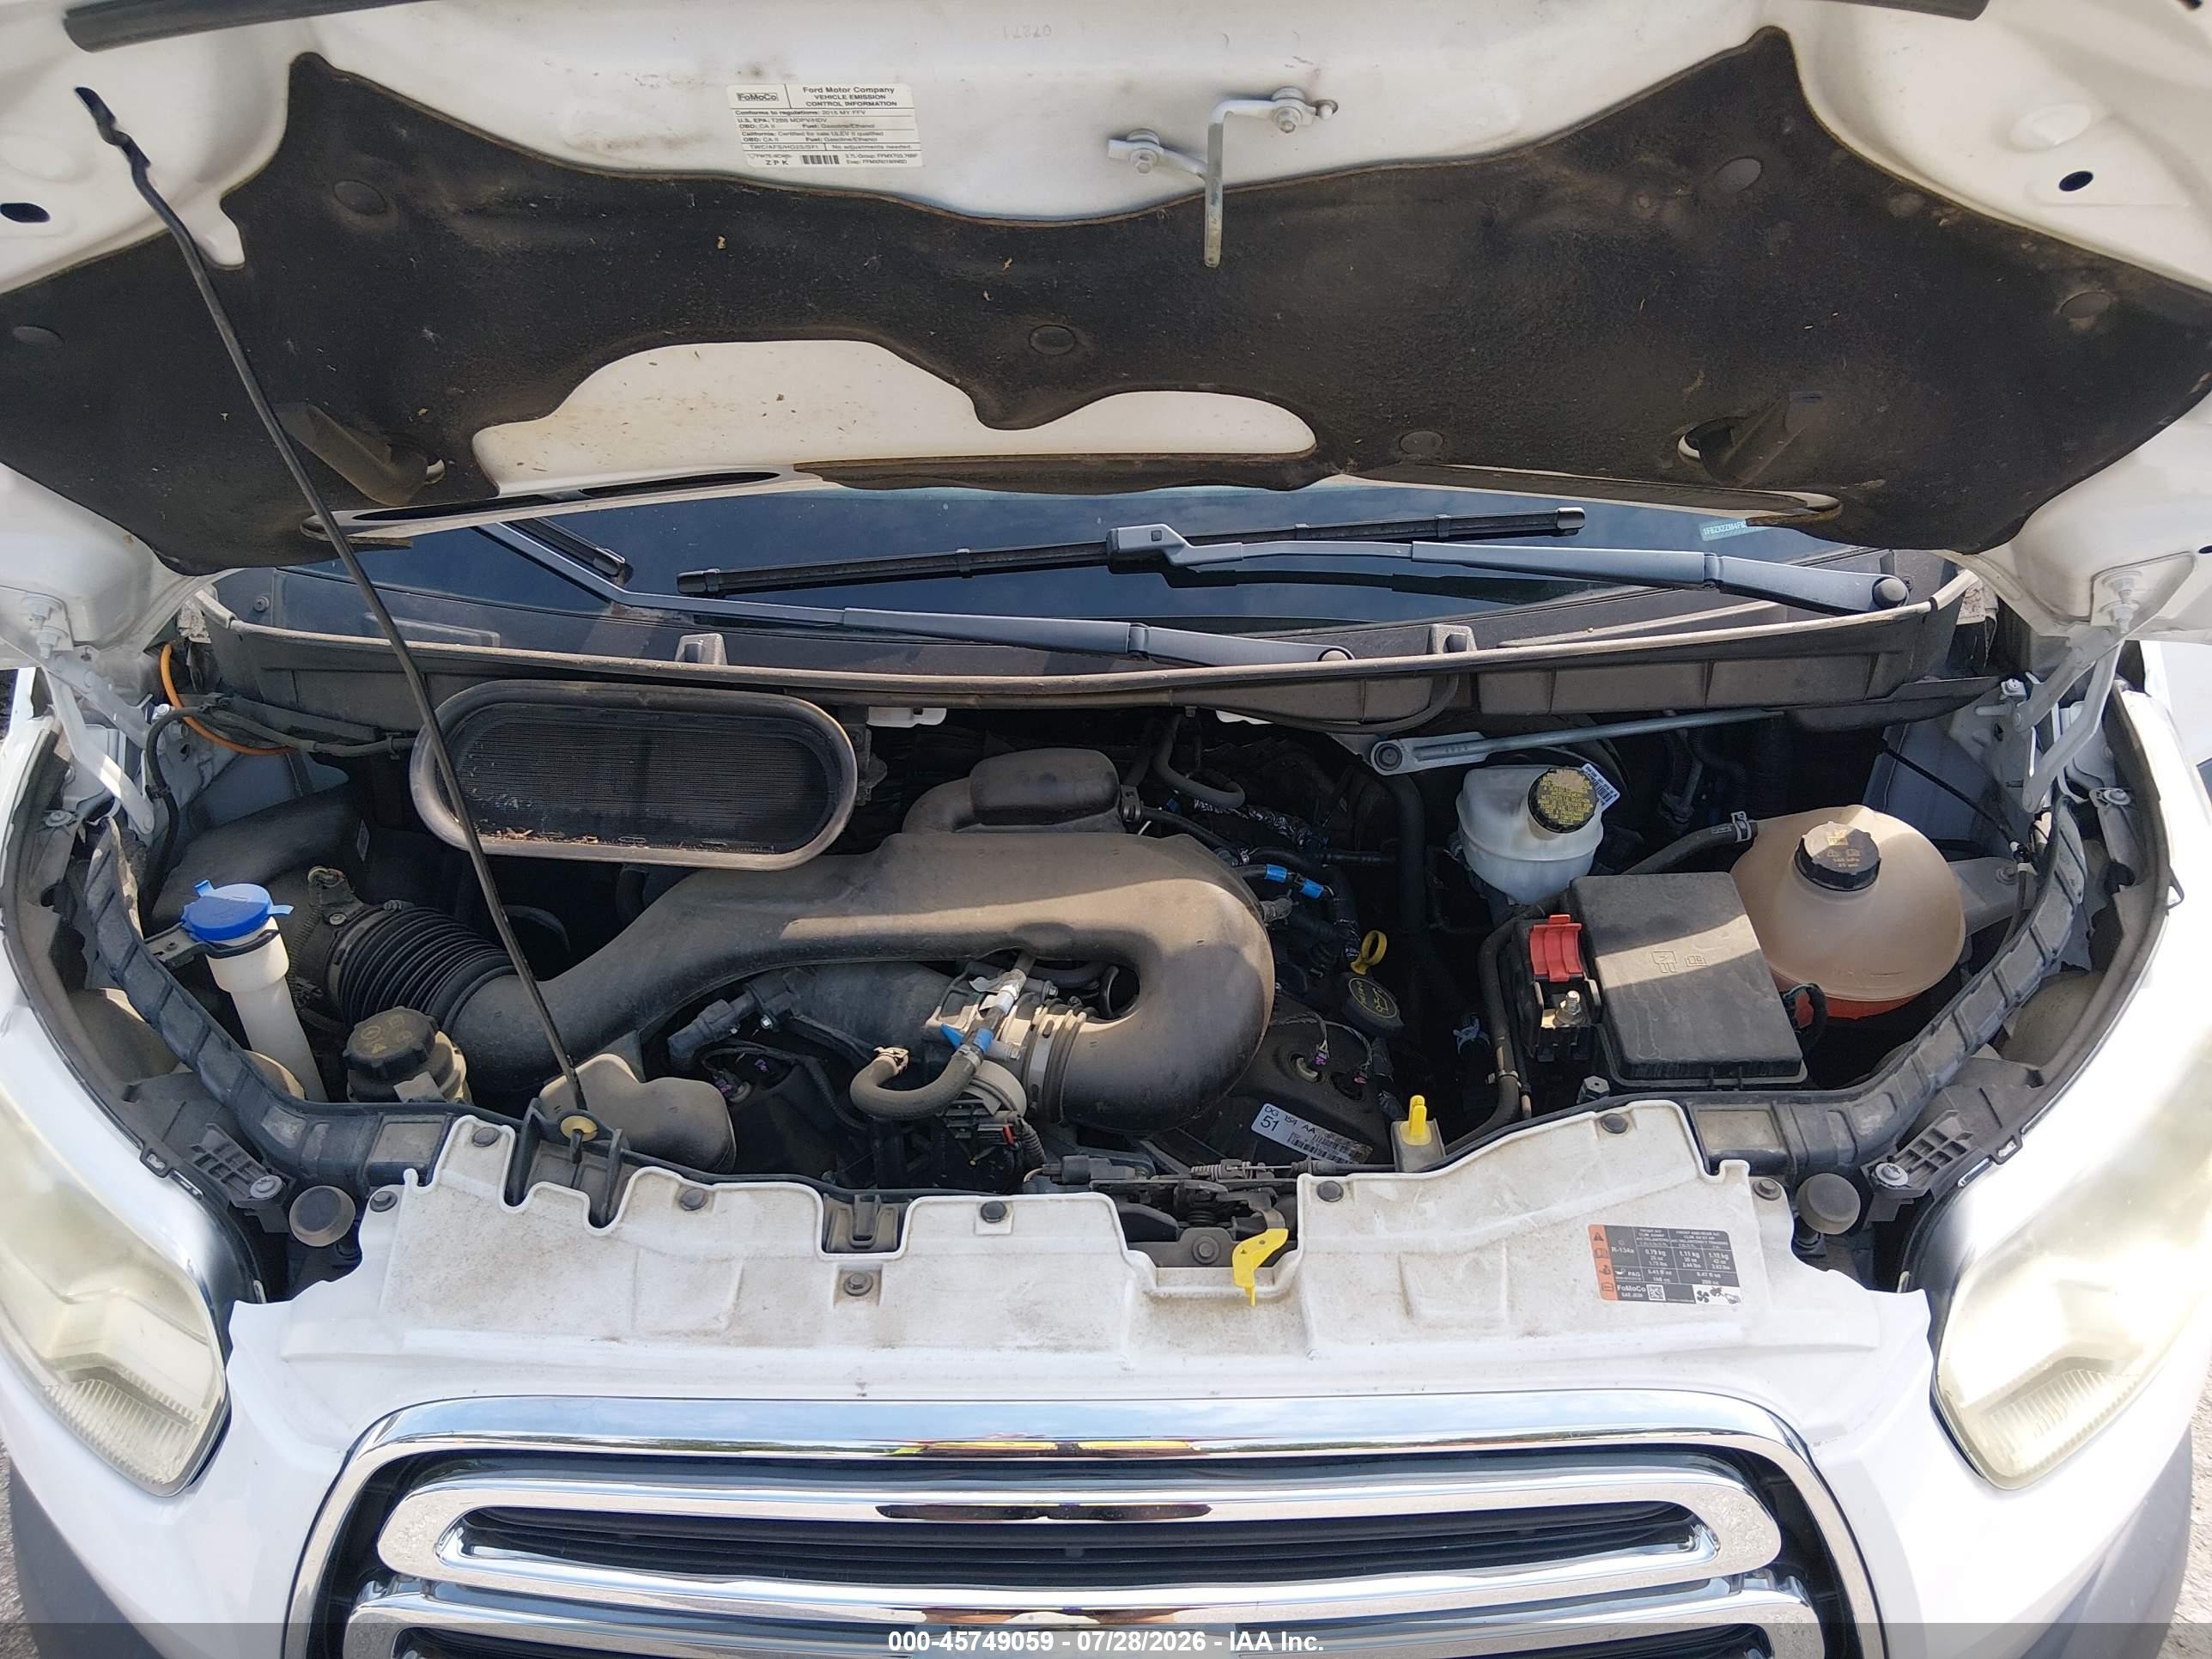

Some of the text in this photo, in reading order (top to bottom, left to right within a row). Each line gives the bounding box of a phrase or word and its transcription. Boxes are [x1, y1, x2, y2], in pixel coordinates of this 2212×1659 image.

[737, 93, 778, 101] FoMoCo
[1260, 1115, 1279, 1132] 51
[1264, 1105, 1279, 1117] DG
[1303, 1124, 1316, 1134] AA
[1721, 1252, 1729, 1261] kg
[1616, 1284, 1646, 1292] FoMoCo
